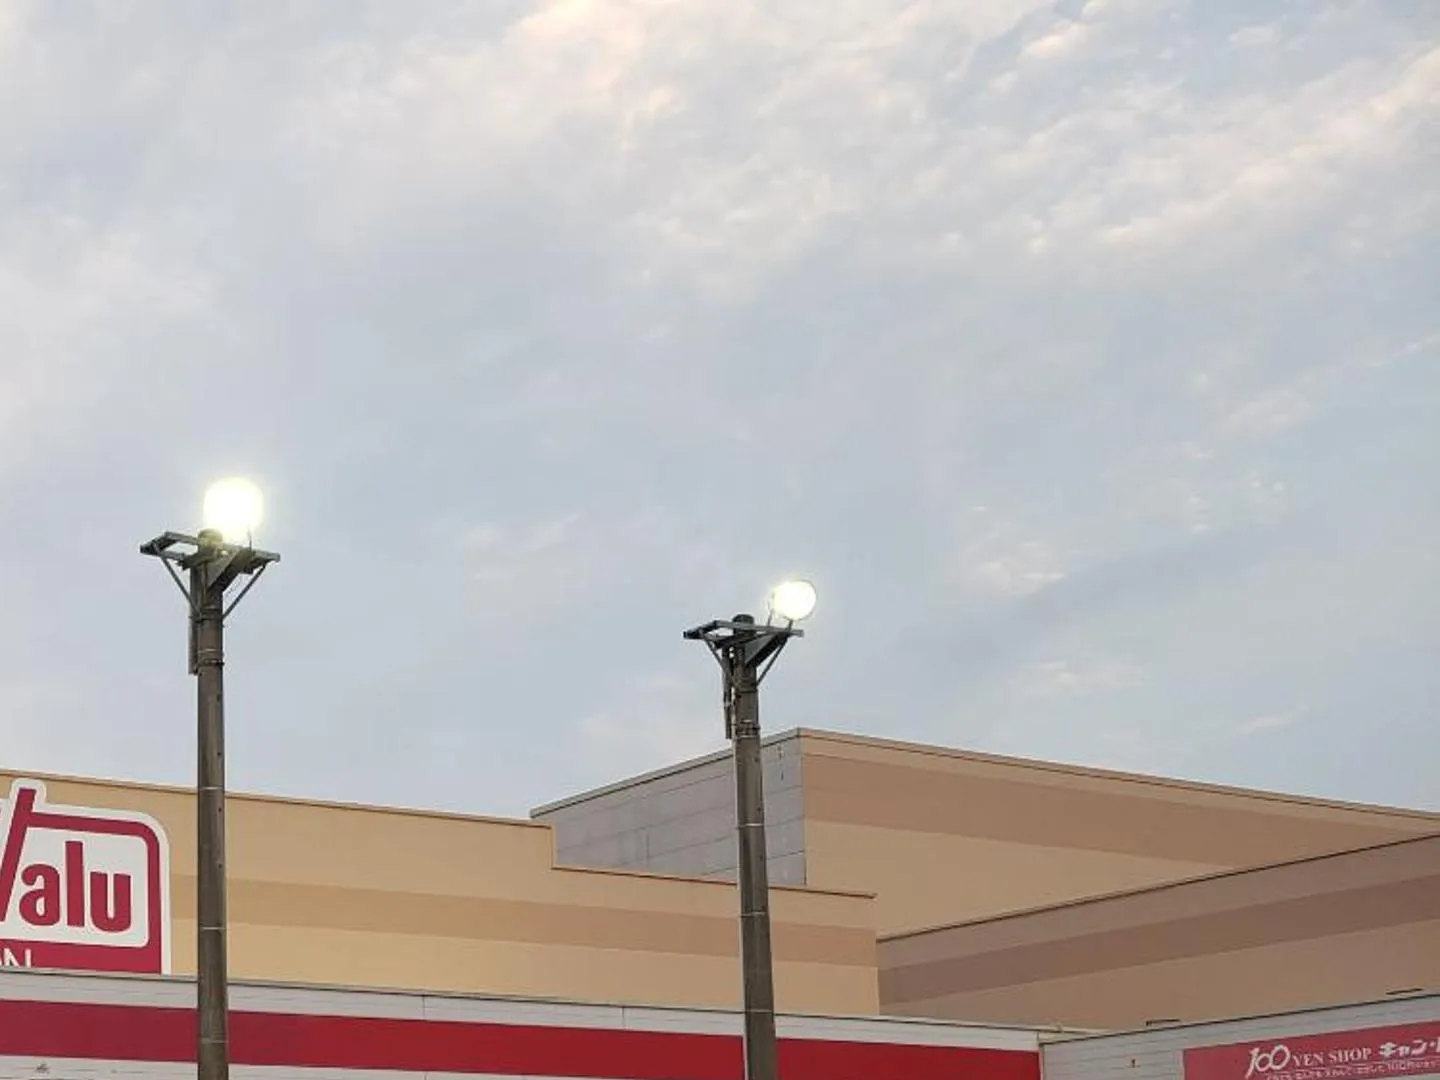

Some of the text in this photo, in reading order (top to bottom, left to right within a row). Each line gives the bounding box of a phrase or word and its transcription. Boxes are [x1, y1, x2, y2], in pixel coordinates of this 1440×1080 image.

[1245, 1044, 1291, 1080] 100
[1293, 1052, 1325, 1067] YEN
[1329, 1047, 1372, 1064] SHOP
